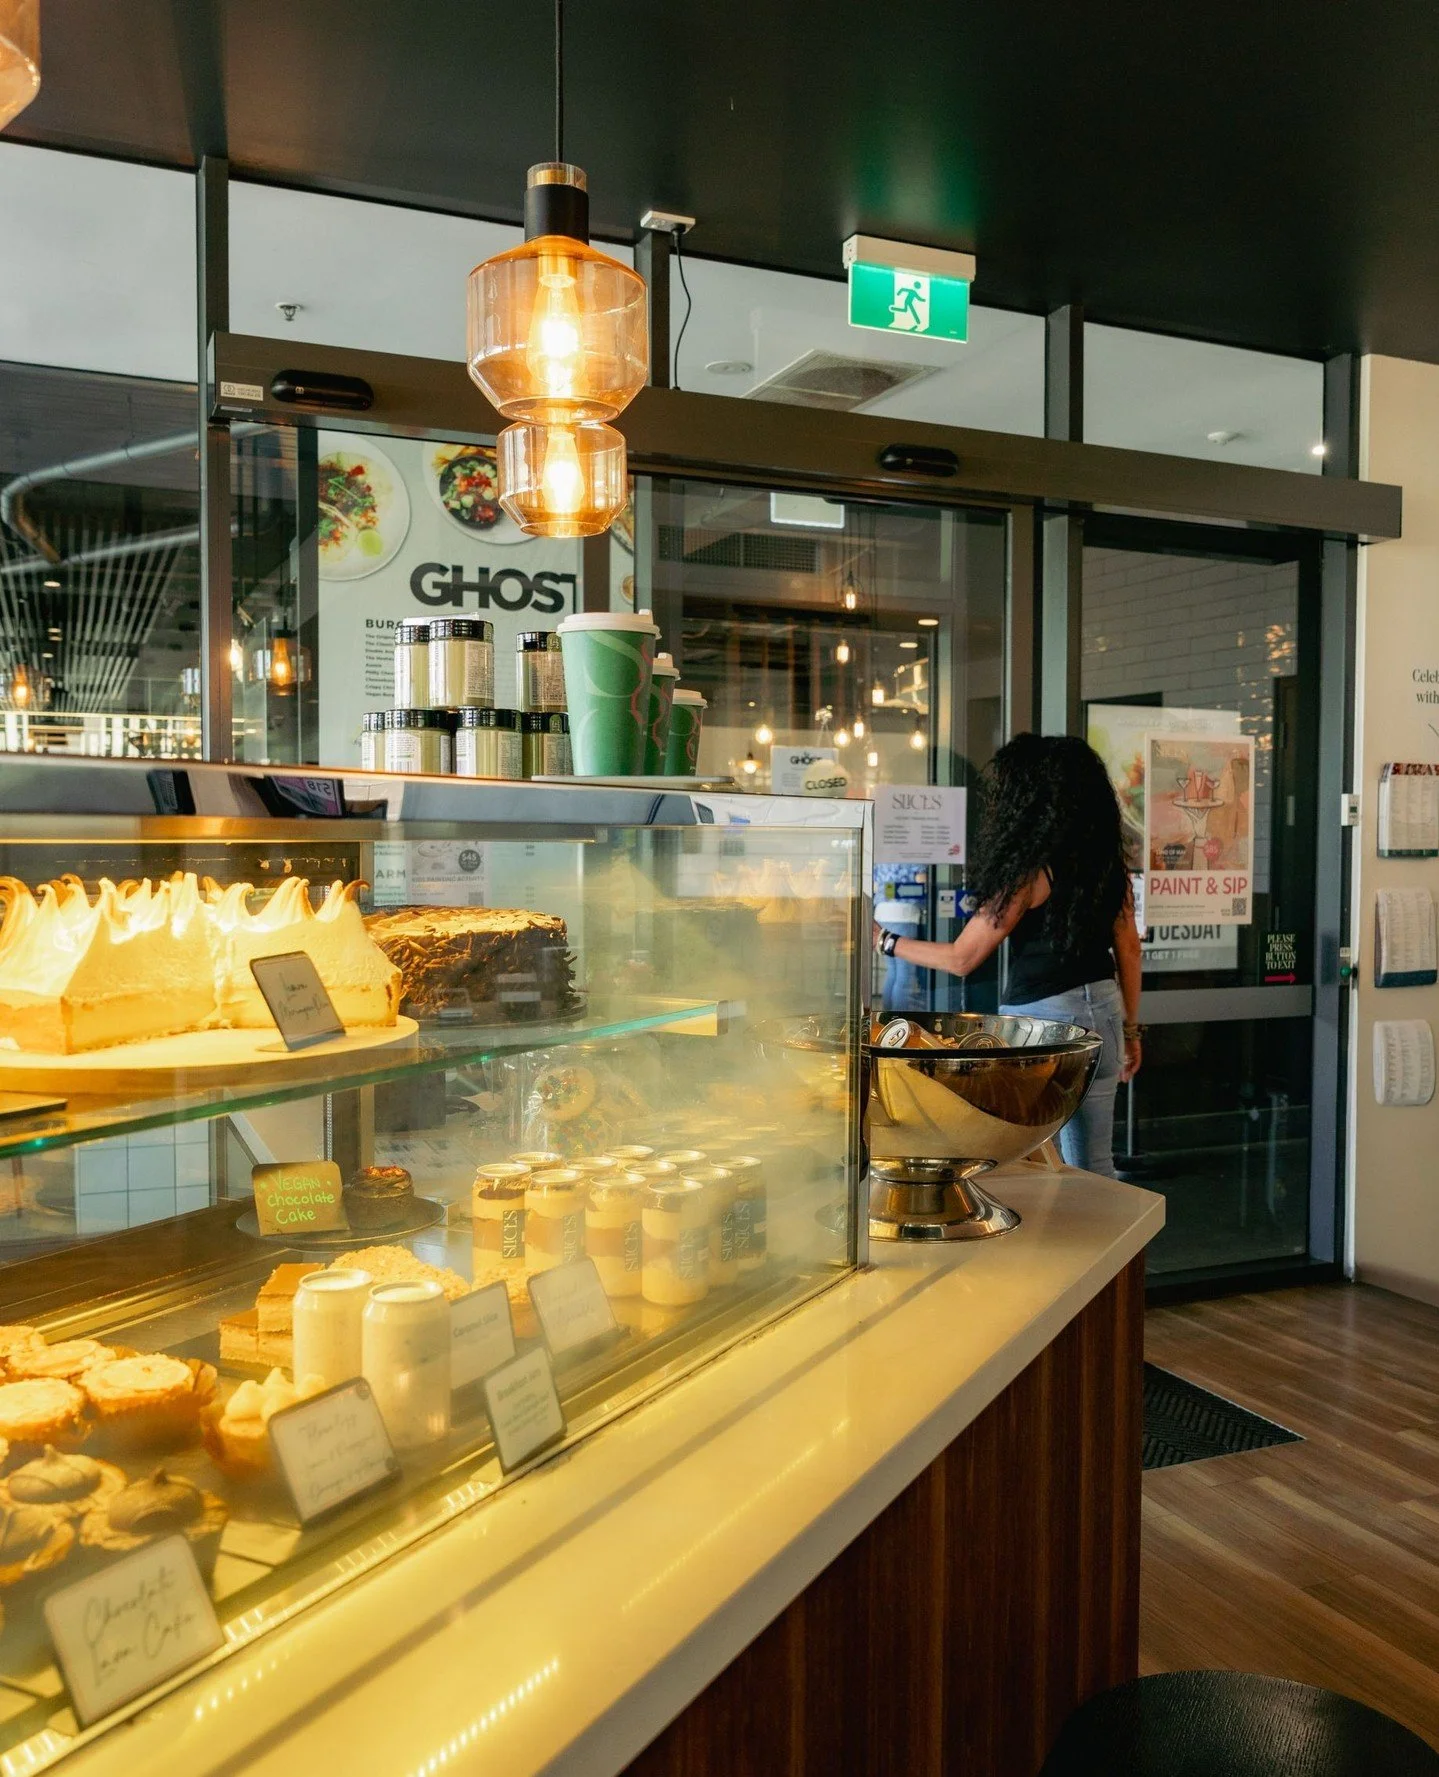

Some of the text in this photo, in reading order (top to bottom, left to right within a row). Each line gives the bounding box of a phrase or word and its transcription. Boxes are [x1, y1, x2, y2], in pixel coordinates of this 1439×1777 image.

[805, 777, 848, 790] CLOSED
[1150, 876, 1248, 895] PAINT & SIP
[1267, 934, 1296, 944] PLEASE
[1270, 943, 1293, 951] PRESS
[1151, 950, 1169, 960] GET
[1265, 951, 1296, 961] BUTTON
[1266, 960, 1296, 970] TO EXIT
[270, 1169, 320, 1191] VEGAN
[276, 1208, 316, 1225] Cake
[504, 1210, 517, 1258] SLICES
